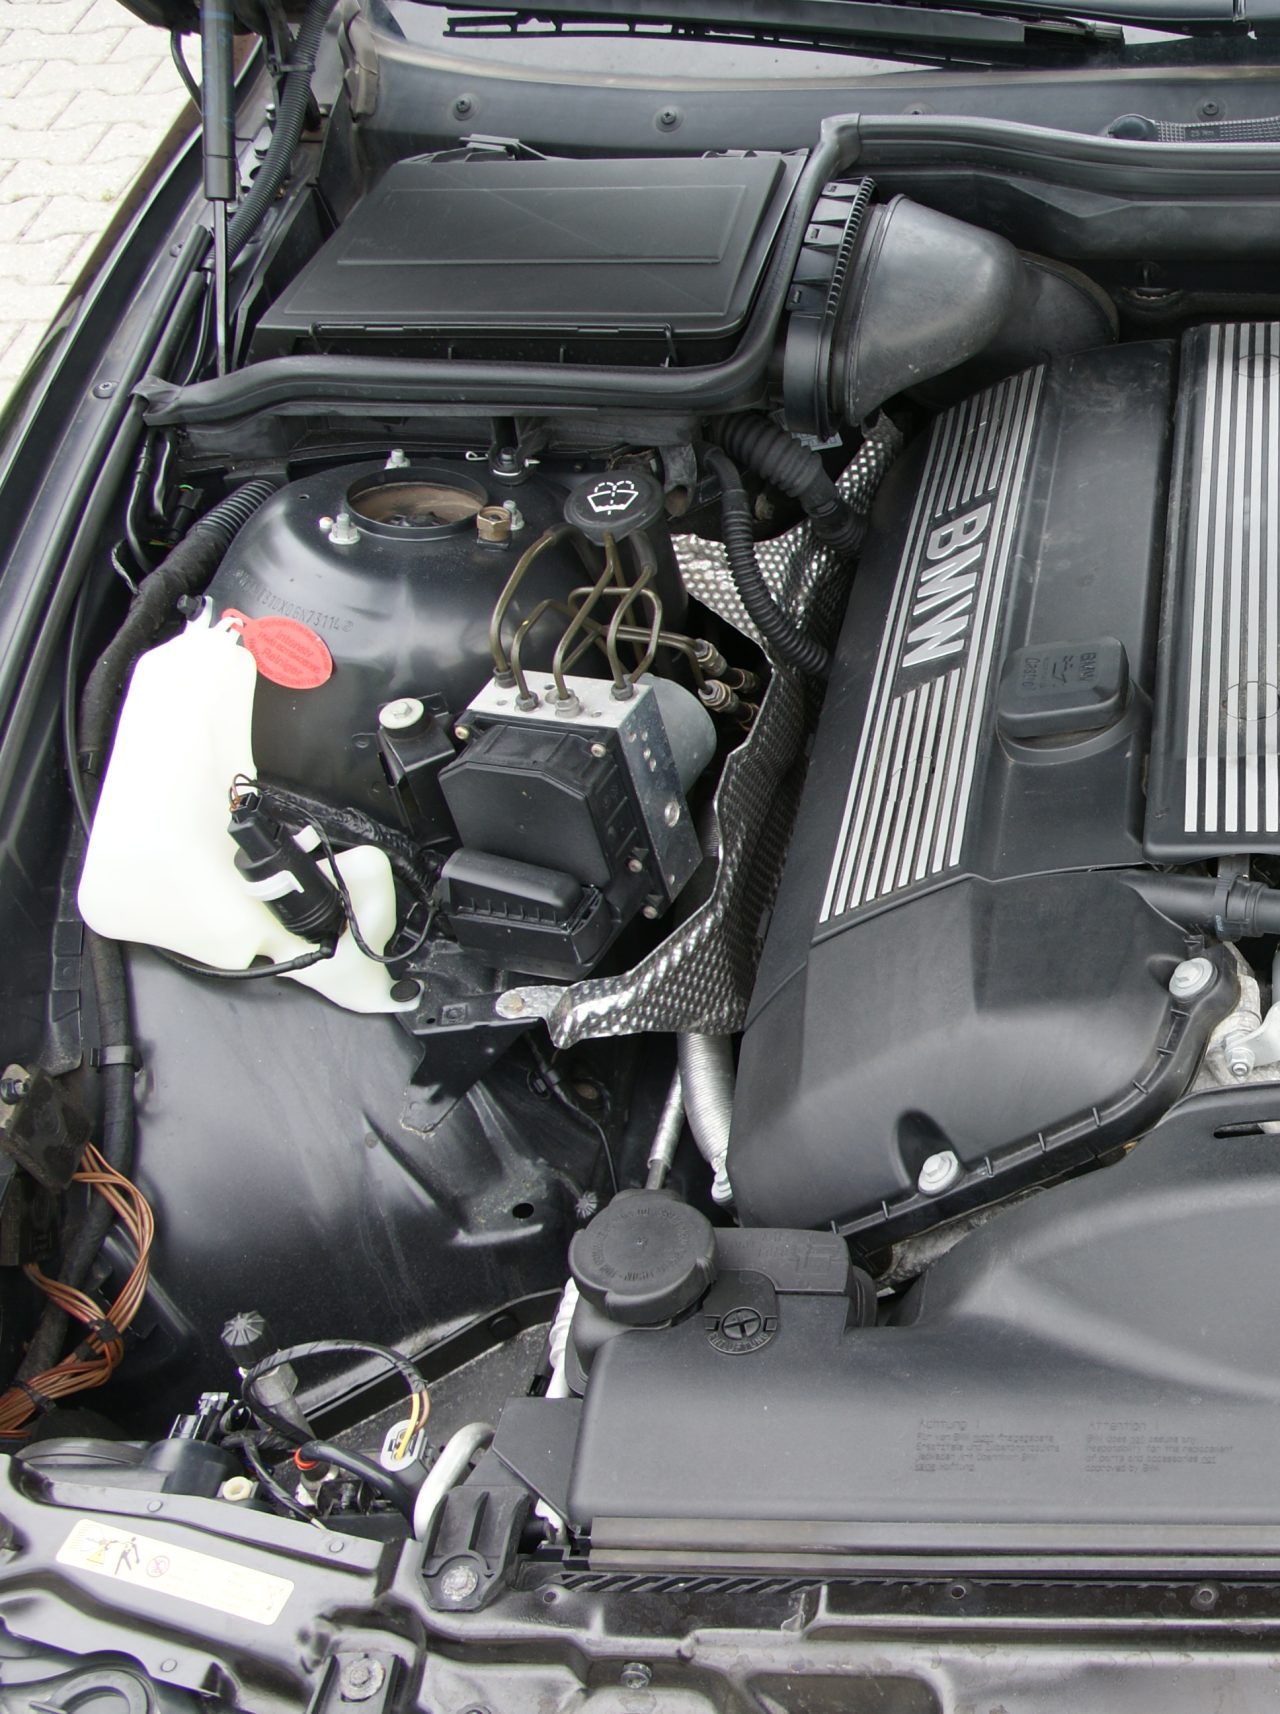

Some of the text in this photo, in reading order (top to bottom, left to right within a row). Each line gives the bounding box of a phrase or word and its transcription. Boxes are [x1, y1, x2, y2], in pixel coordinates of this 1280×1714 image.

[902, 501, 992, 668] BMW
[919, 1418, 968, 1431] Achtung
[1088, 1420, 1146, 1431] Attention
